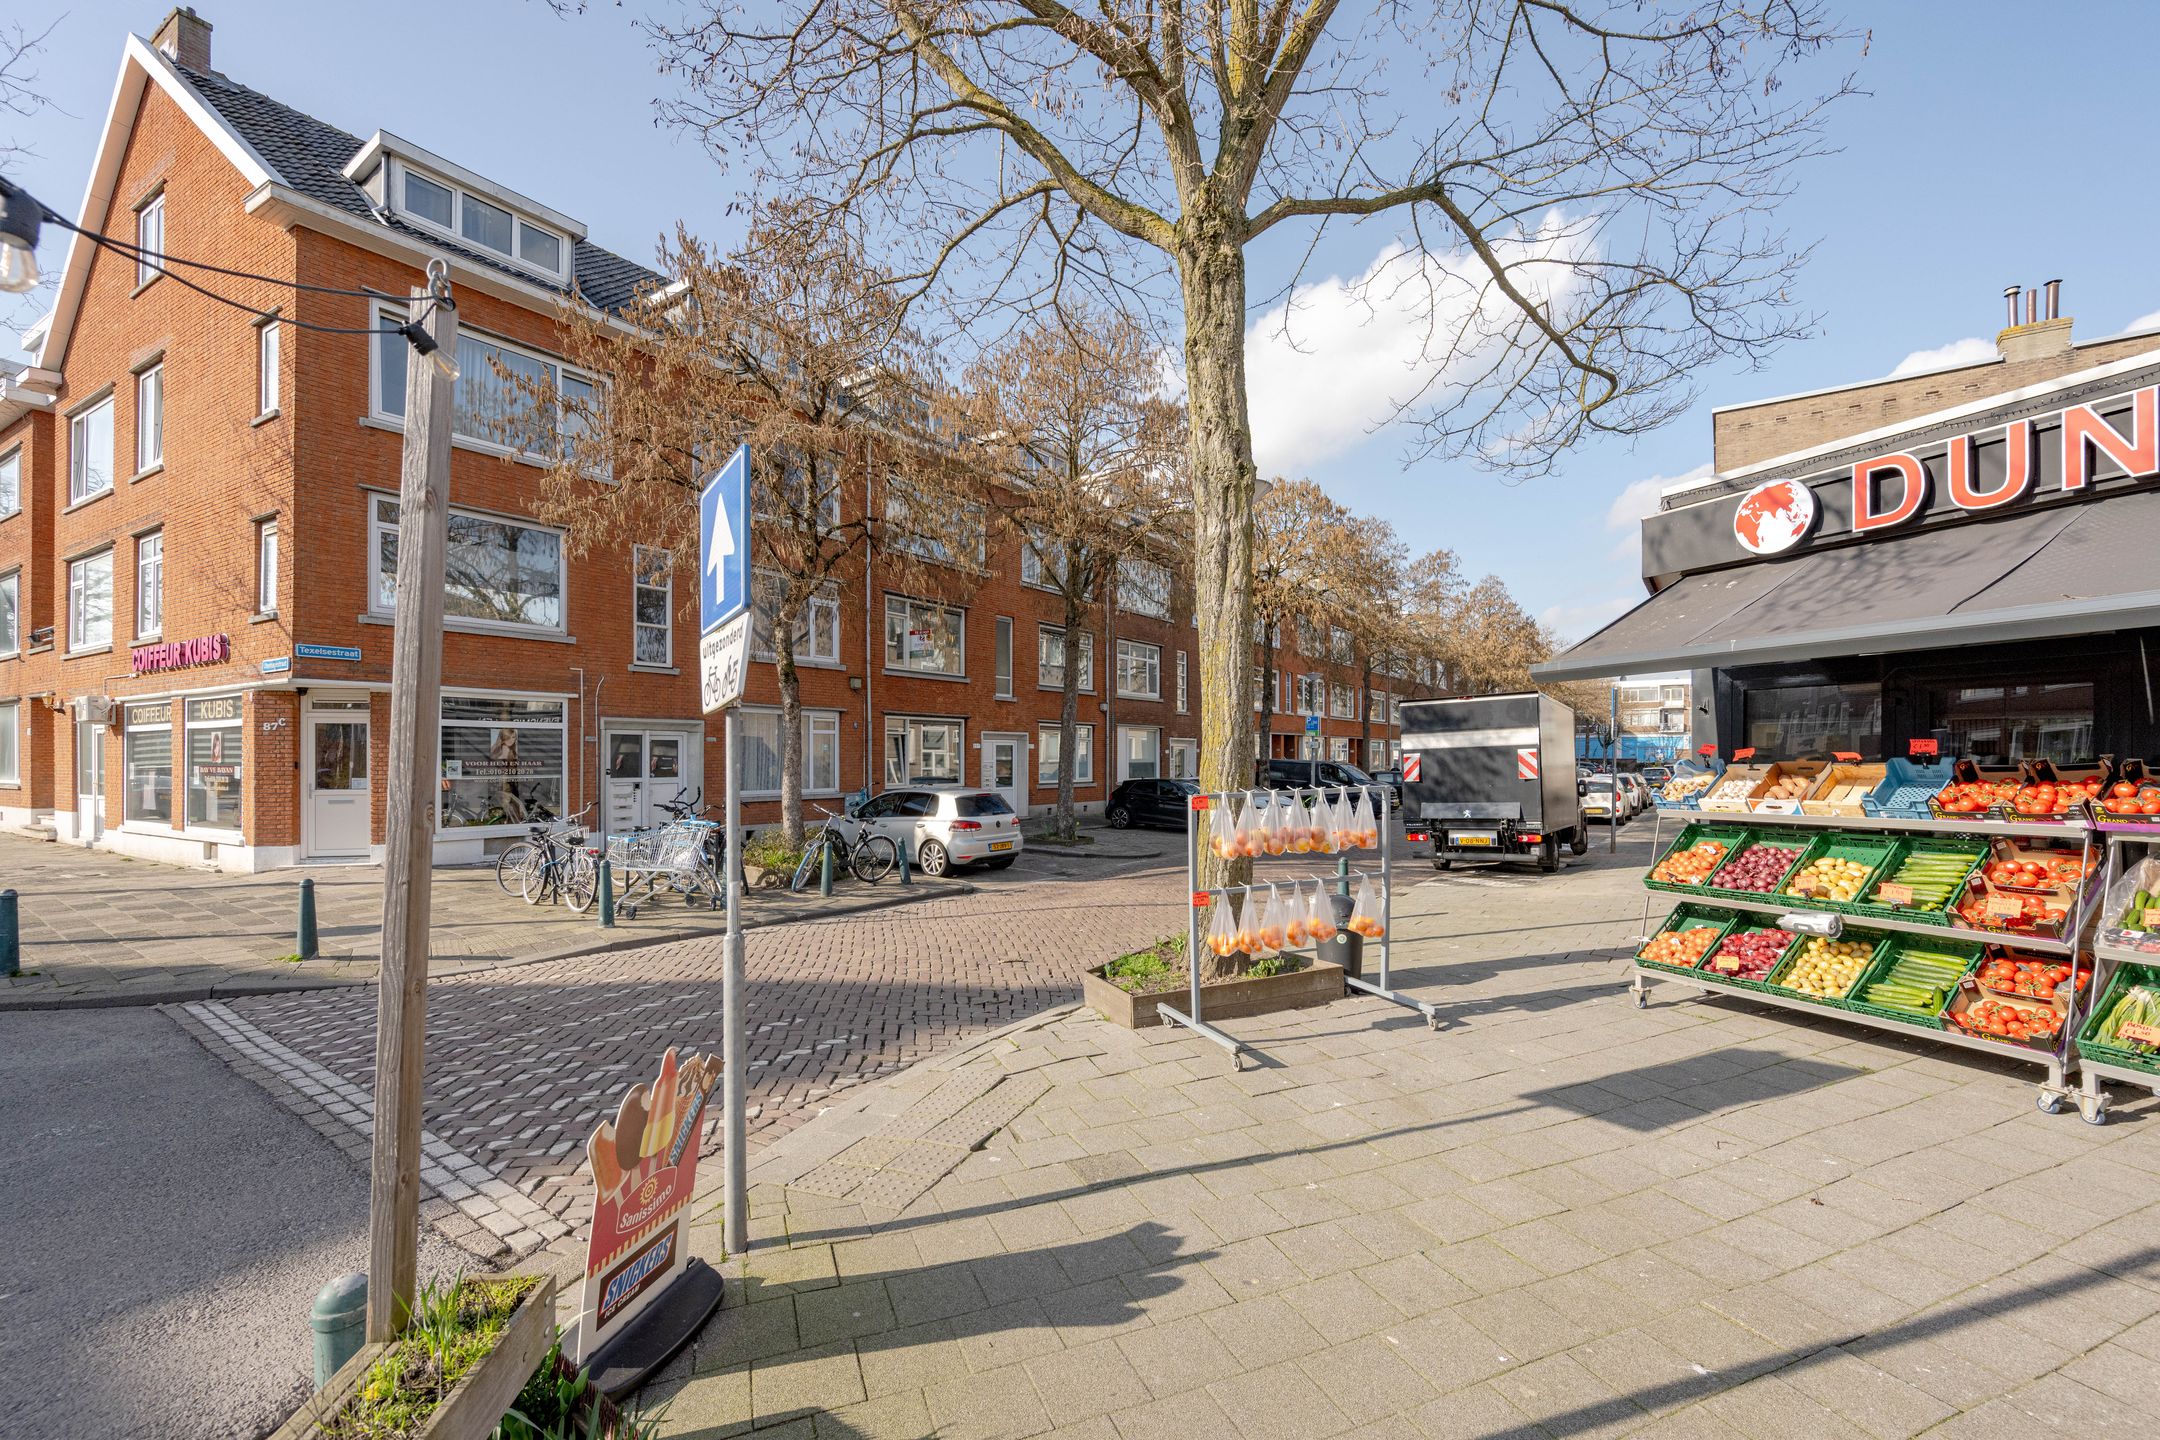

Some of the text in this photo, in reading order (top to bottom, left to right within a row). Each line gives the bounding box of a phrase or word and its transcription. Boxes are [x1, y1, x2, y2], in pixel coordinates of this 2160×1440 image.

[1852, 385, 2159, 533] DUN
[132, 633, 223, 672] COIFFEUR KUBIS
[299, 646, 359, 658] Texelsestraat
[702, 621, 744, 660] uitgezonderd
[132, 699, 234, 723] COIFFEUR KUBIS
[2097, 815, 2128, 824] GRAND
[669, 1091, 704, 1167] SNICKERS
[619, 1184, 672, 1229] Sanissimo
[604, 1235, 674, 1306] SNICKERS
[603, 1283, 641, 1319] ICE CREAM
